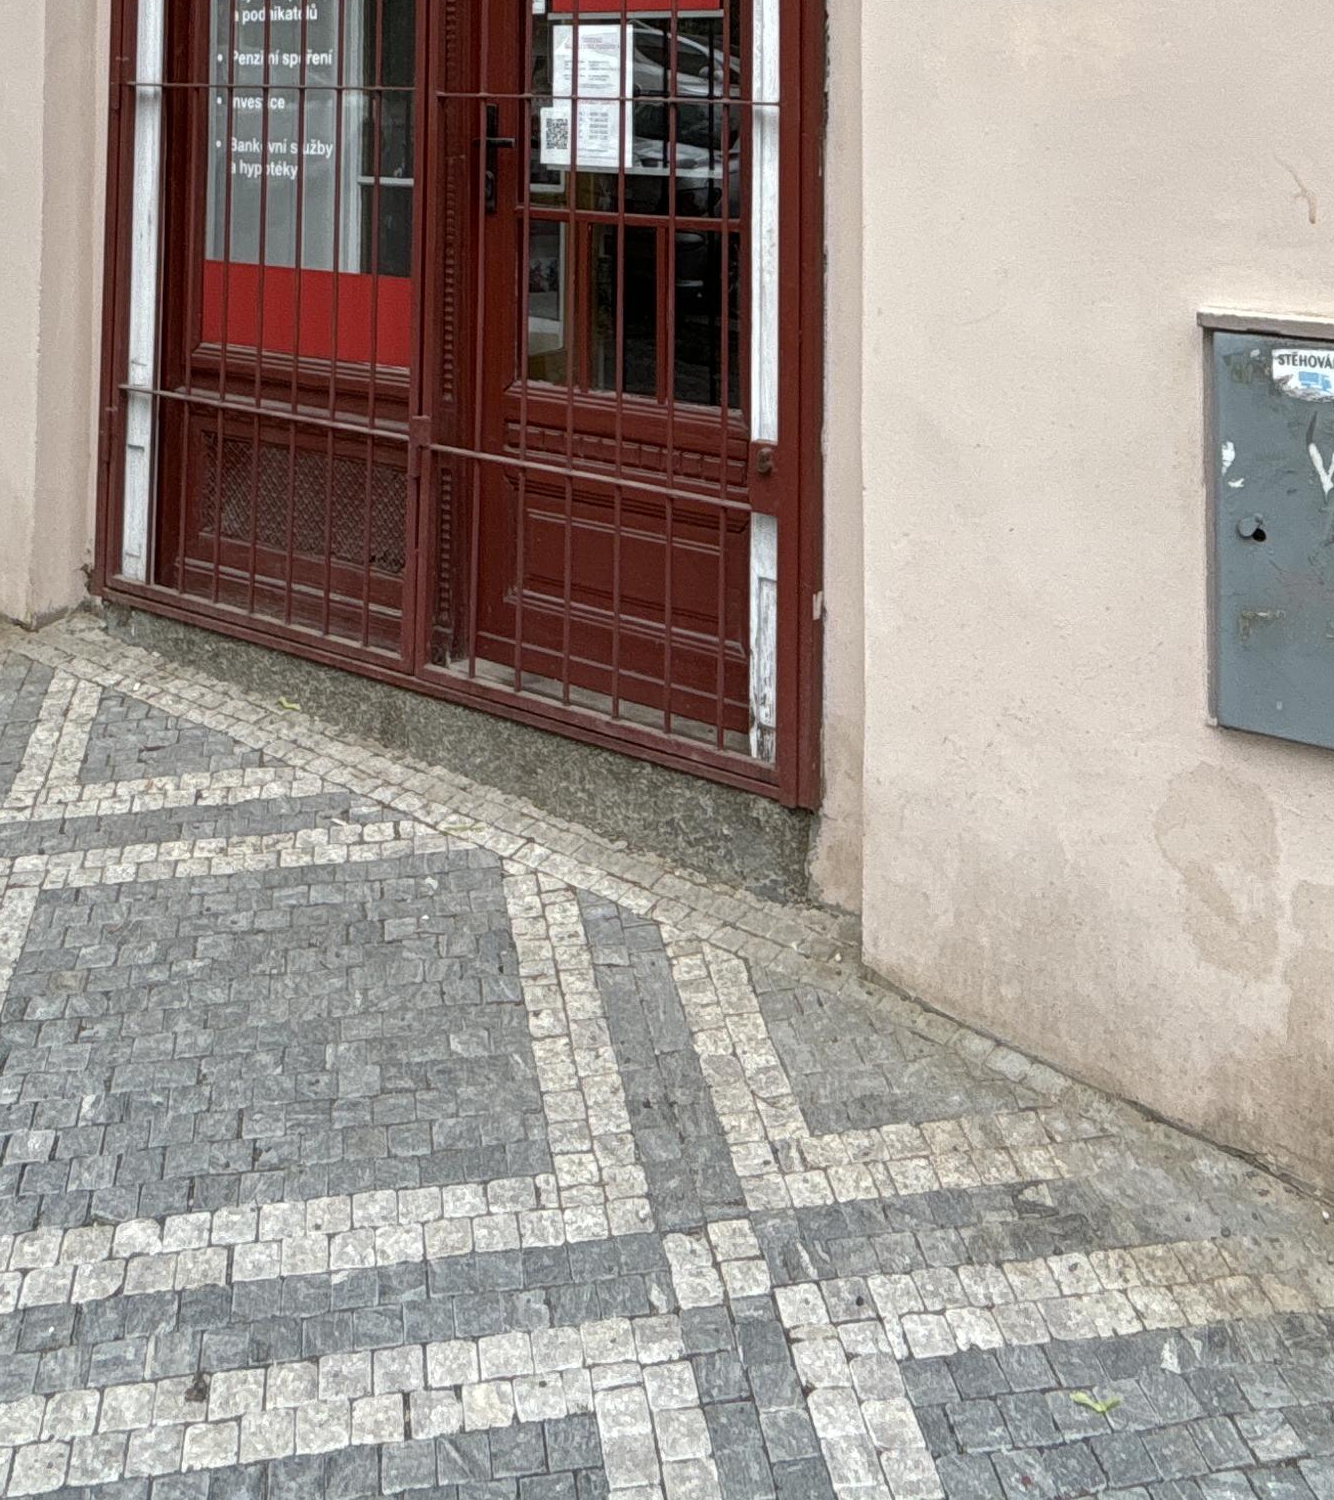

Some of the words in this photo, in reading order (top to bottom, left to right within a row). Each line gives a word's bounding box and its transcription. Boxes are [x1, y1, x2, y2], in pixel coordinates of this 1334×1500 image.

[242, 3, 318, 25] podikatlů
[233, 50, 280, 66] enziní
[282, 49, 333, 68] spření
[232, 96, 285, 110] nvesce
[231, 137, 288, 155] Bankvní
[290, 138, 334, 159] sužby
